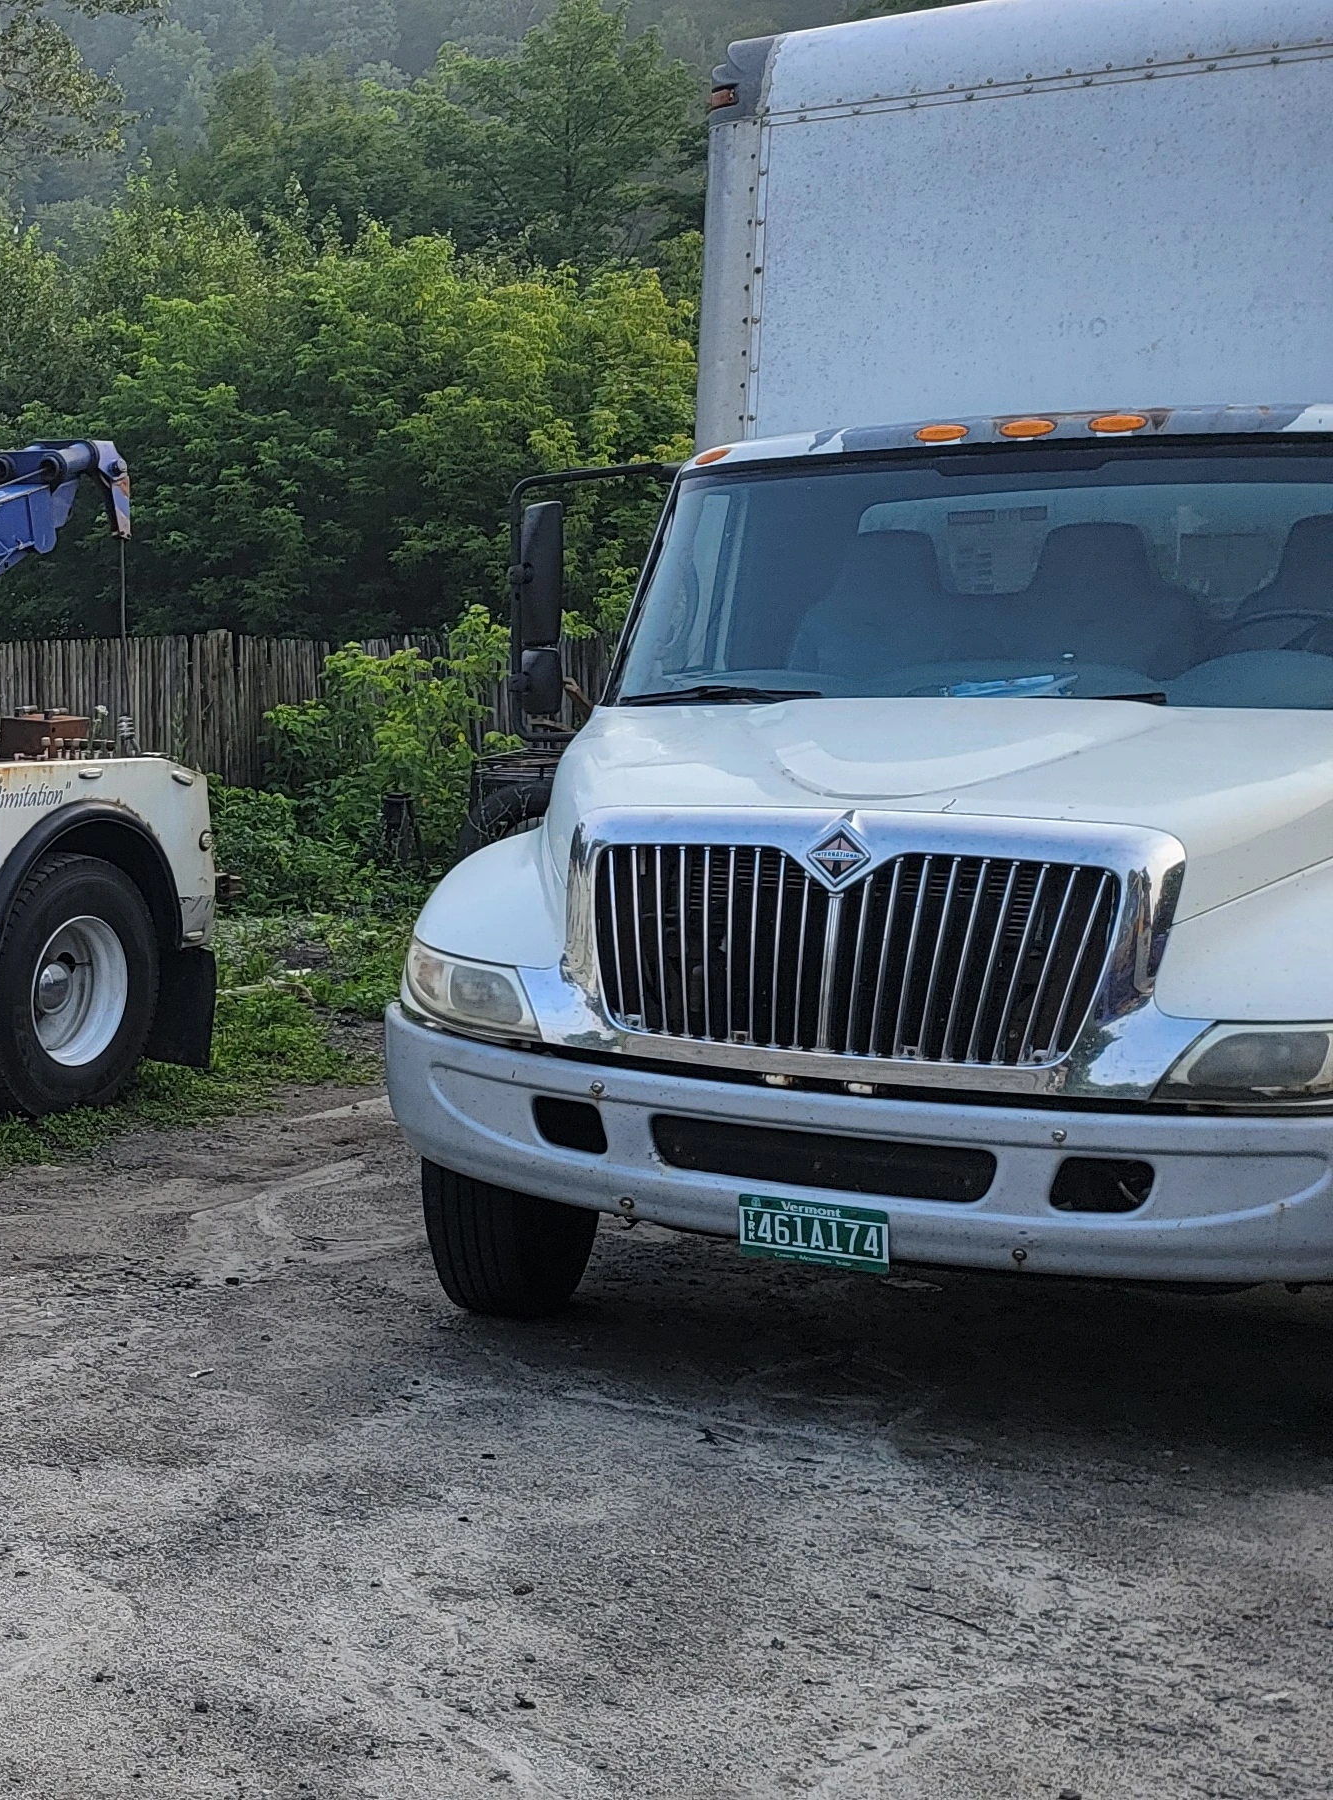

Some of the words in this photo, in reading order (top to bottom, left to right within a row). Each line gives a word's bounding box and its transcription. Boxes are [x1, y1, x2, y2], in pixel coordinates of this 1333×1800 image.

[781, 1200, 841, 1217] Vermont
[747, 1210, 756, 1241] TRK
[757, 1212, 880, 1257] 461A174
